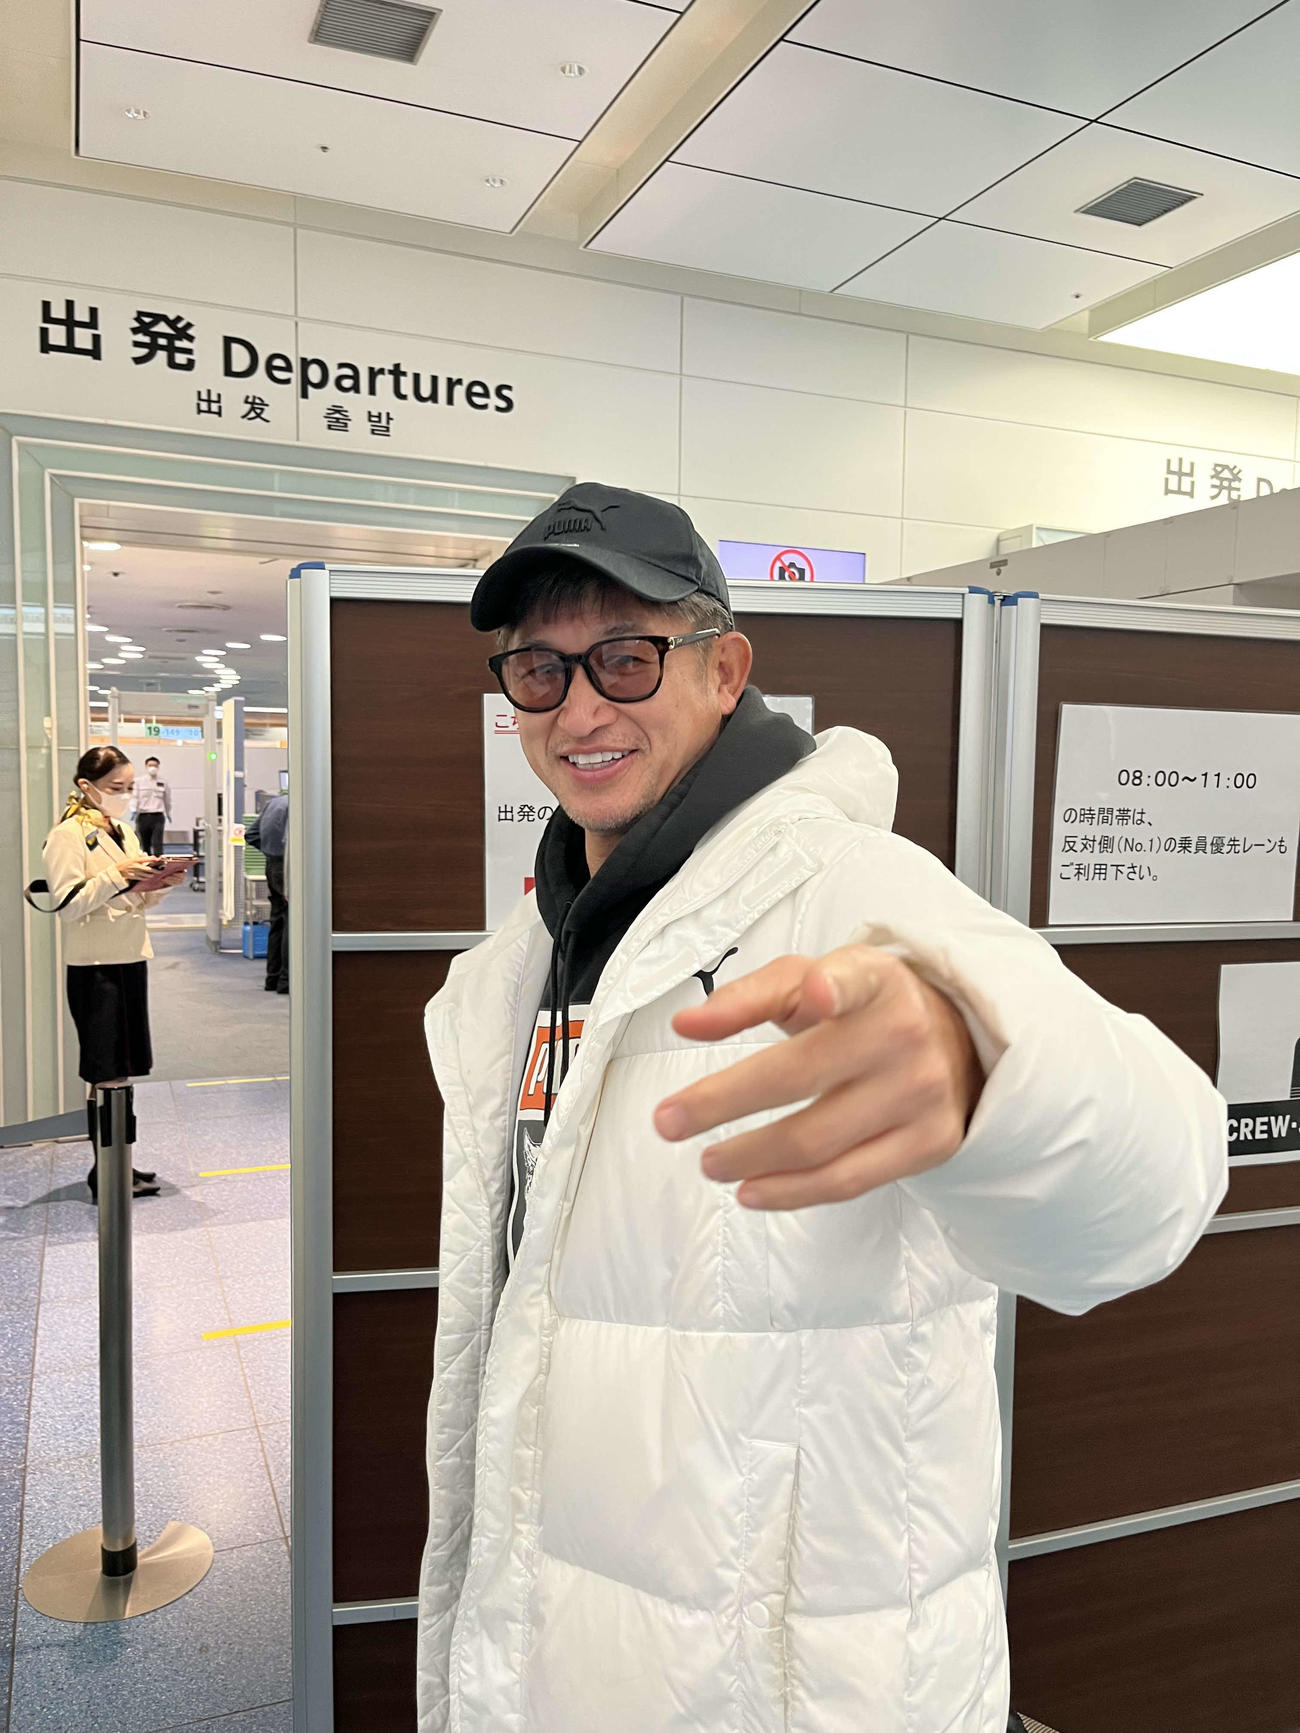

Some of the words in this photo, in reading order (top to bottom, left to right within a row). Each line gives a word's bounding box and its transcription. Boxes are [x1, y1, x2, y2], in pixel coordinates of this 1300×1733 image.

[39, 298, 197, 372] 出発
[221, 335, 515, 414] Departures
[196, 389, 271, 423] 出发
[323, 404, 395, 437] 출발
[1163, 456, 1243, 502] 出発
[147, 726, 161, 737] 19
[497, 803, 554, 824] 出発の
[1062, 806, 1154, 828] の時間帯は、
[1058, 861, 1159, 882] ご利用下さい。
